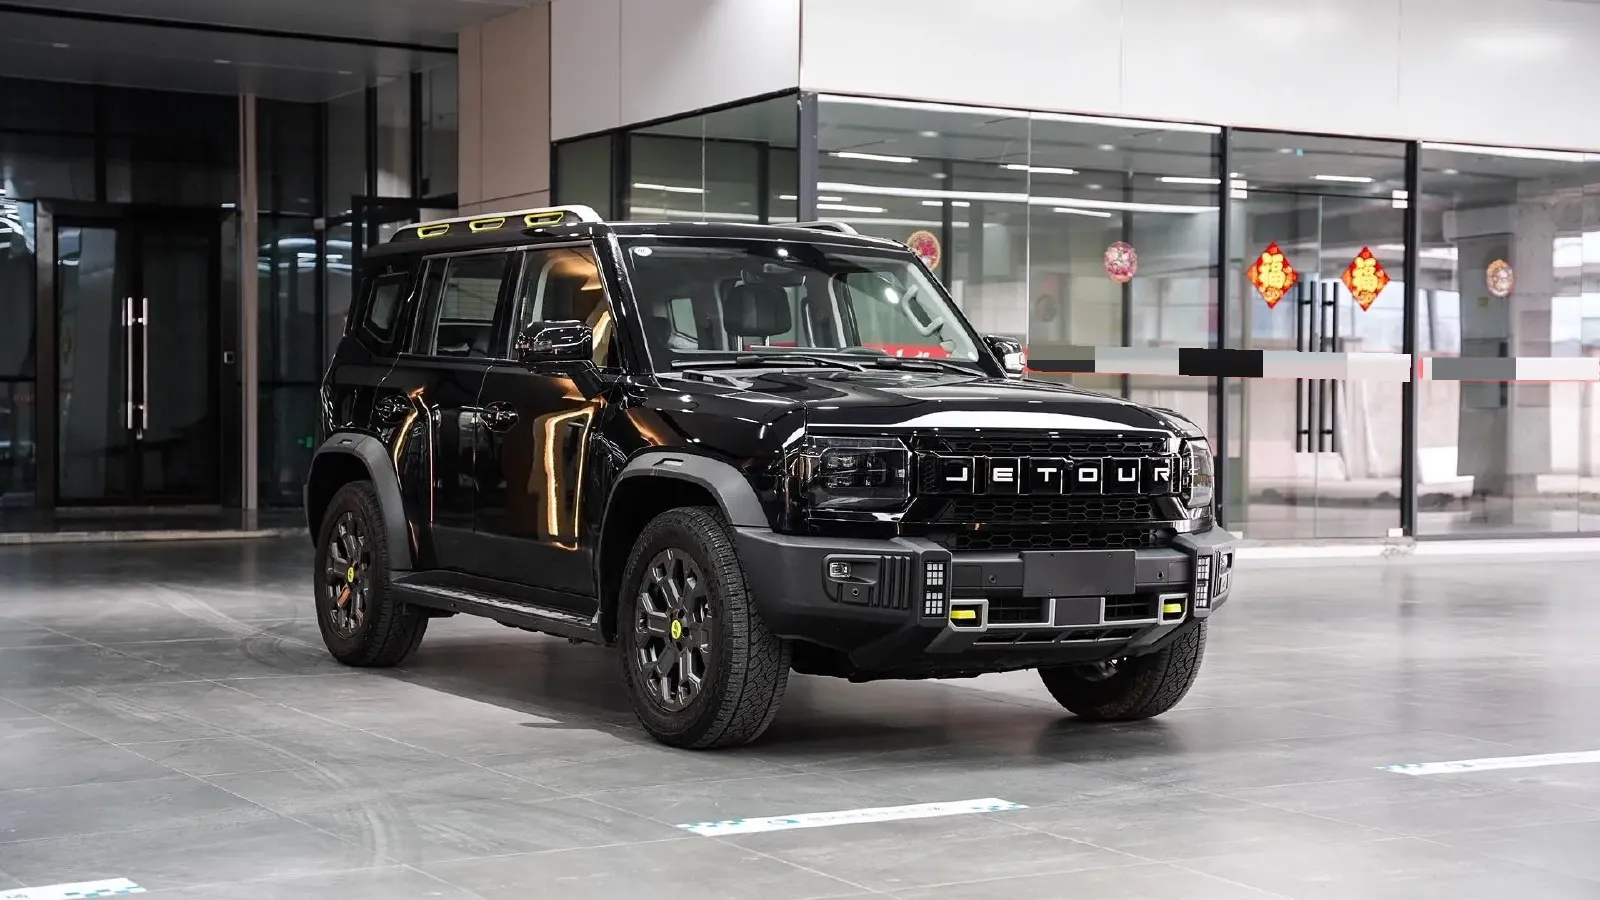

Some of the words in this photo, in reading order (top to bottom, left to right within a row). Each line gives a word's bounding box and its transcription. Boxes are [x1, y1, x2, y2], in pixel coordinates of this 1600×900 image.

[1258, 252, 1286, 289] 福
[1352, 256, 1379, 293] 福
[945, 467, 1171, 482] JETOUR
